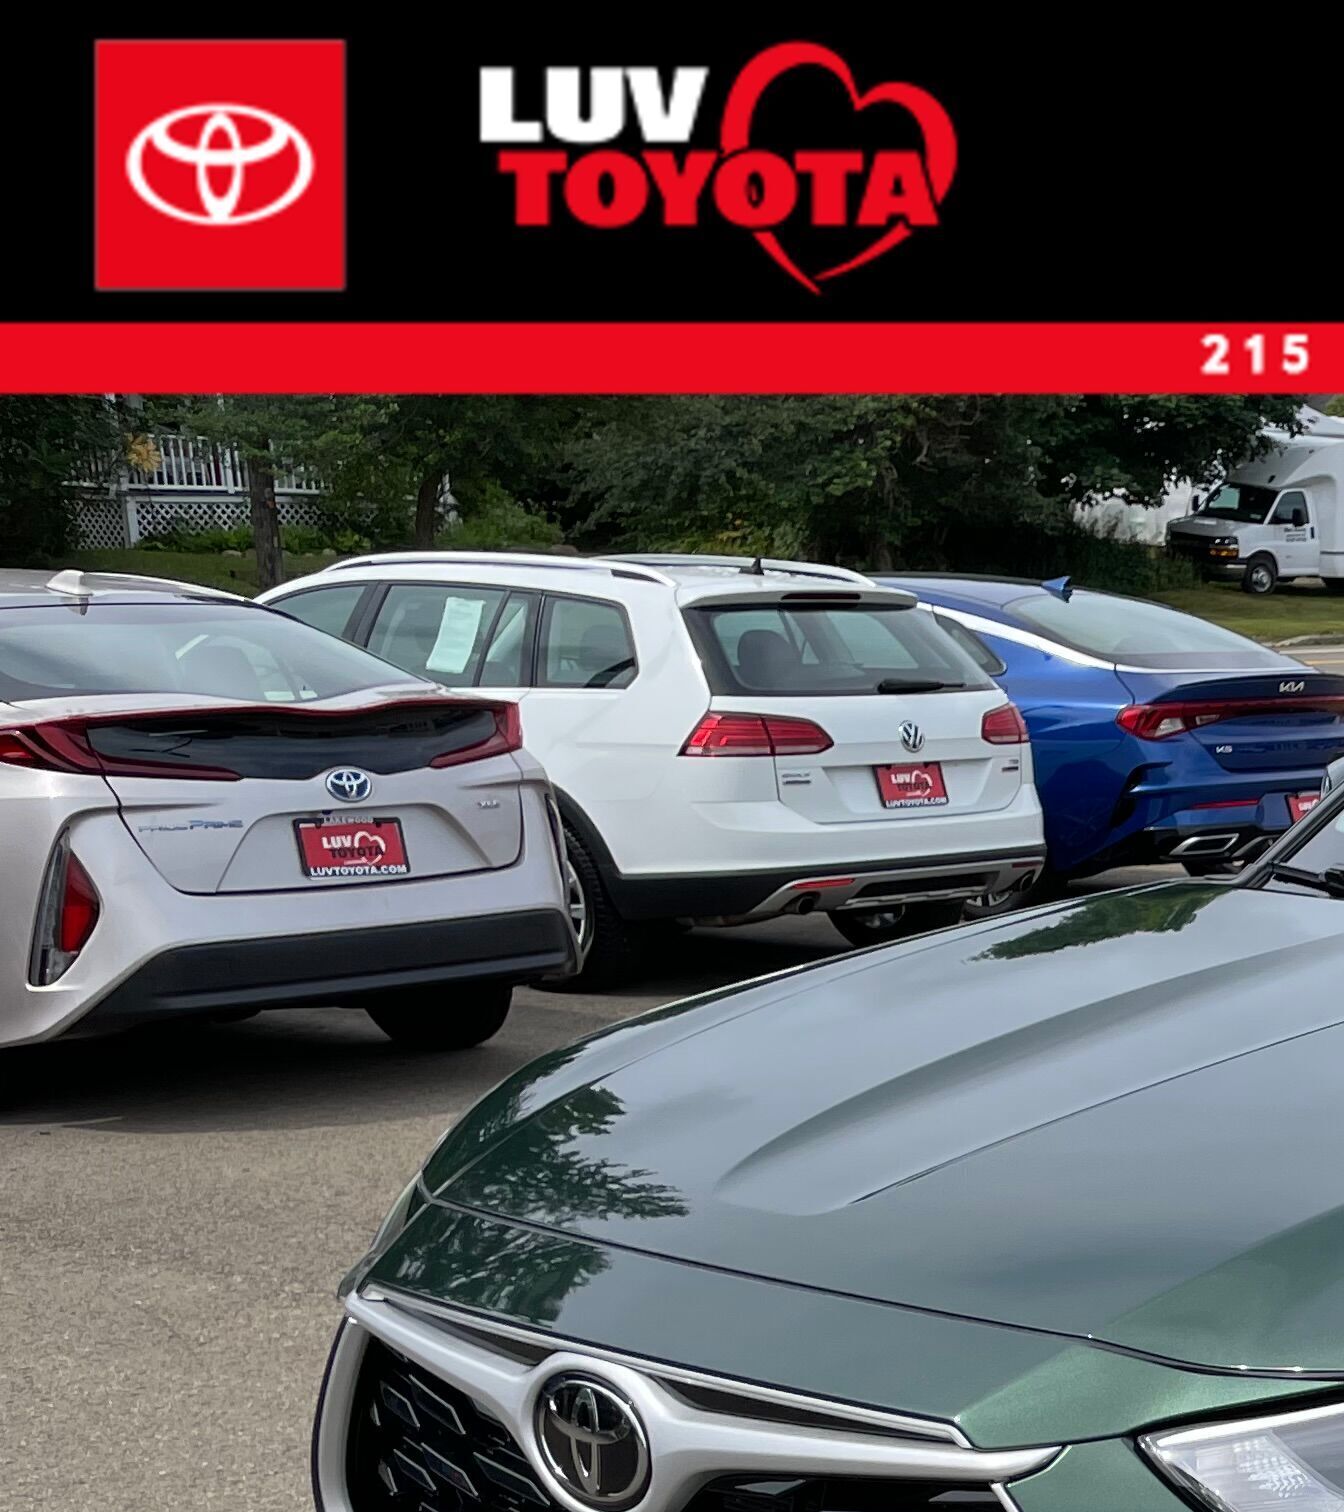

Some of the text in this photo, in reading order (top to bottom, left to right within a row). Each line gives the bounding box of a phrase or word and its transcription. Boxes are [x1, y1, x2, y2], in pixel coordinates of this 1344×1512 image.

[322, 835, 352, 848] LUV
[330, 845, 385, 858] TOYOTA
[310, 865, 408, 877] LUVTOYOTA.COM
